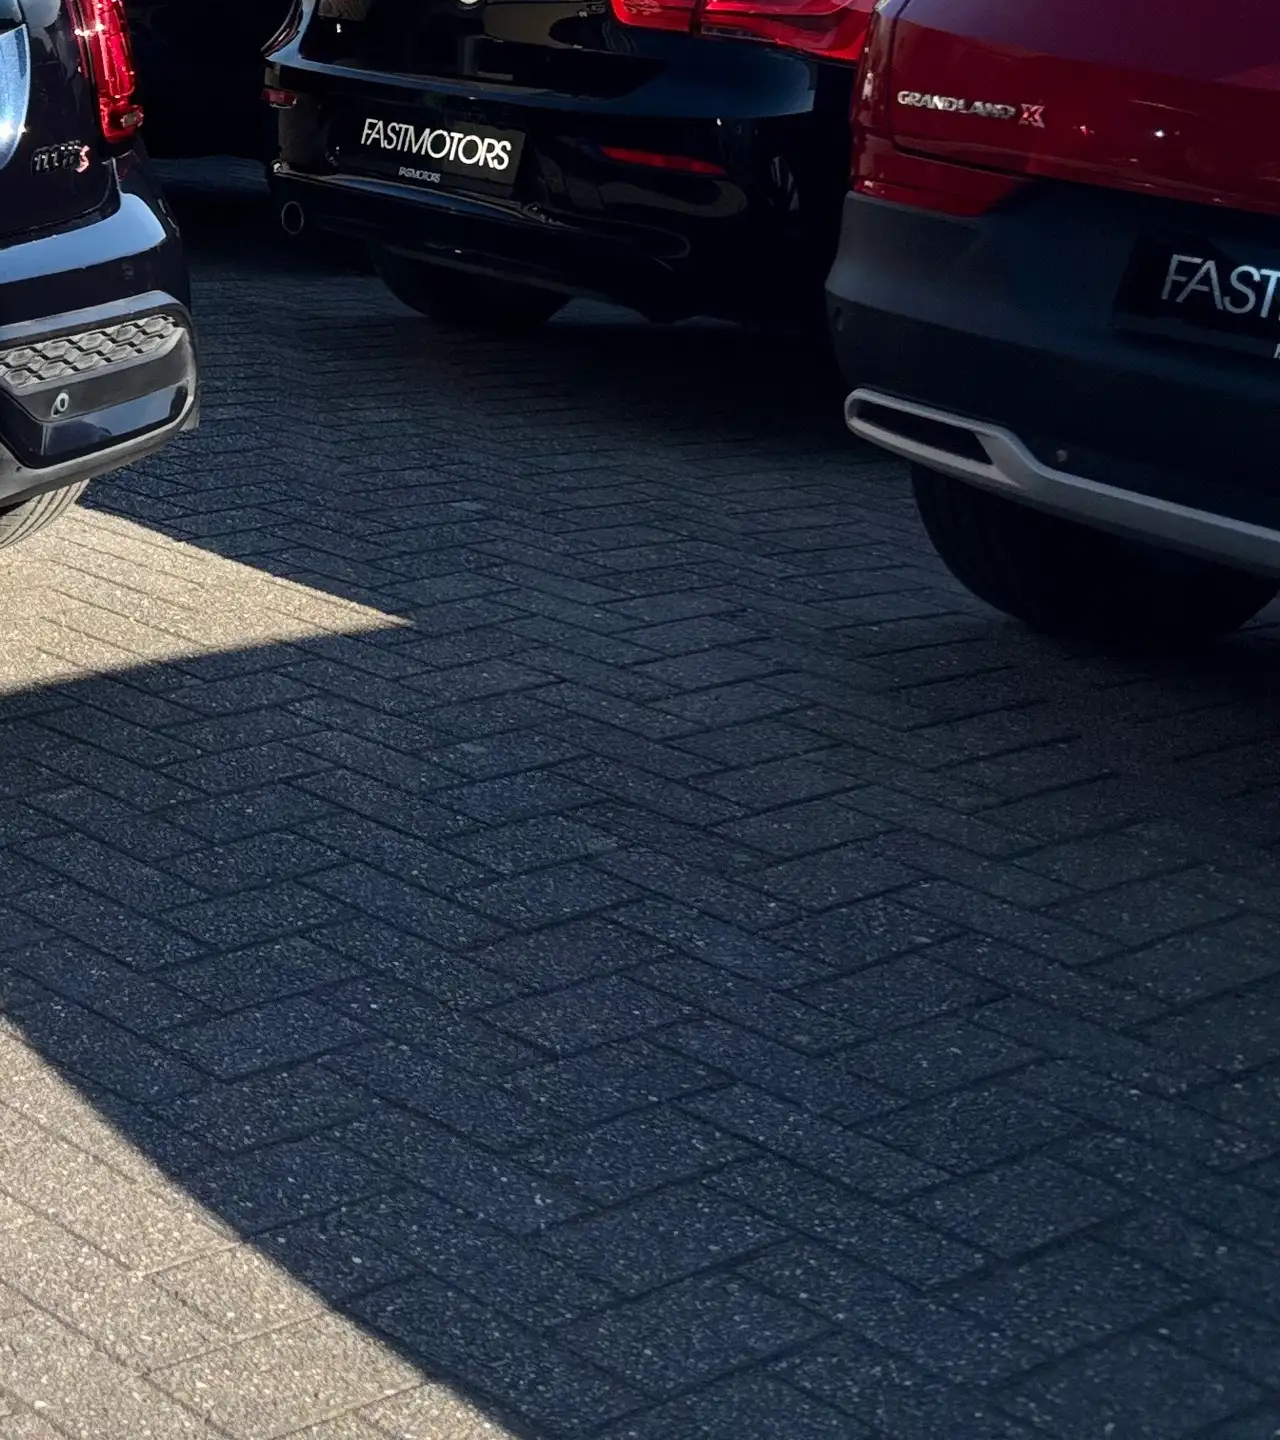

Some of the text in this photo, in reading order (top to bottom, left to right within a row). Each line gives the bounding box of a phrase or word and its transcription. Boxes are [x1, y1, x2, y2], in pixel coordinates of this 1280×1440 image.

[897, 90, 1045, 128] GRANDLAND X
[361, 118, 512, 170] FASTMOTORS
